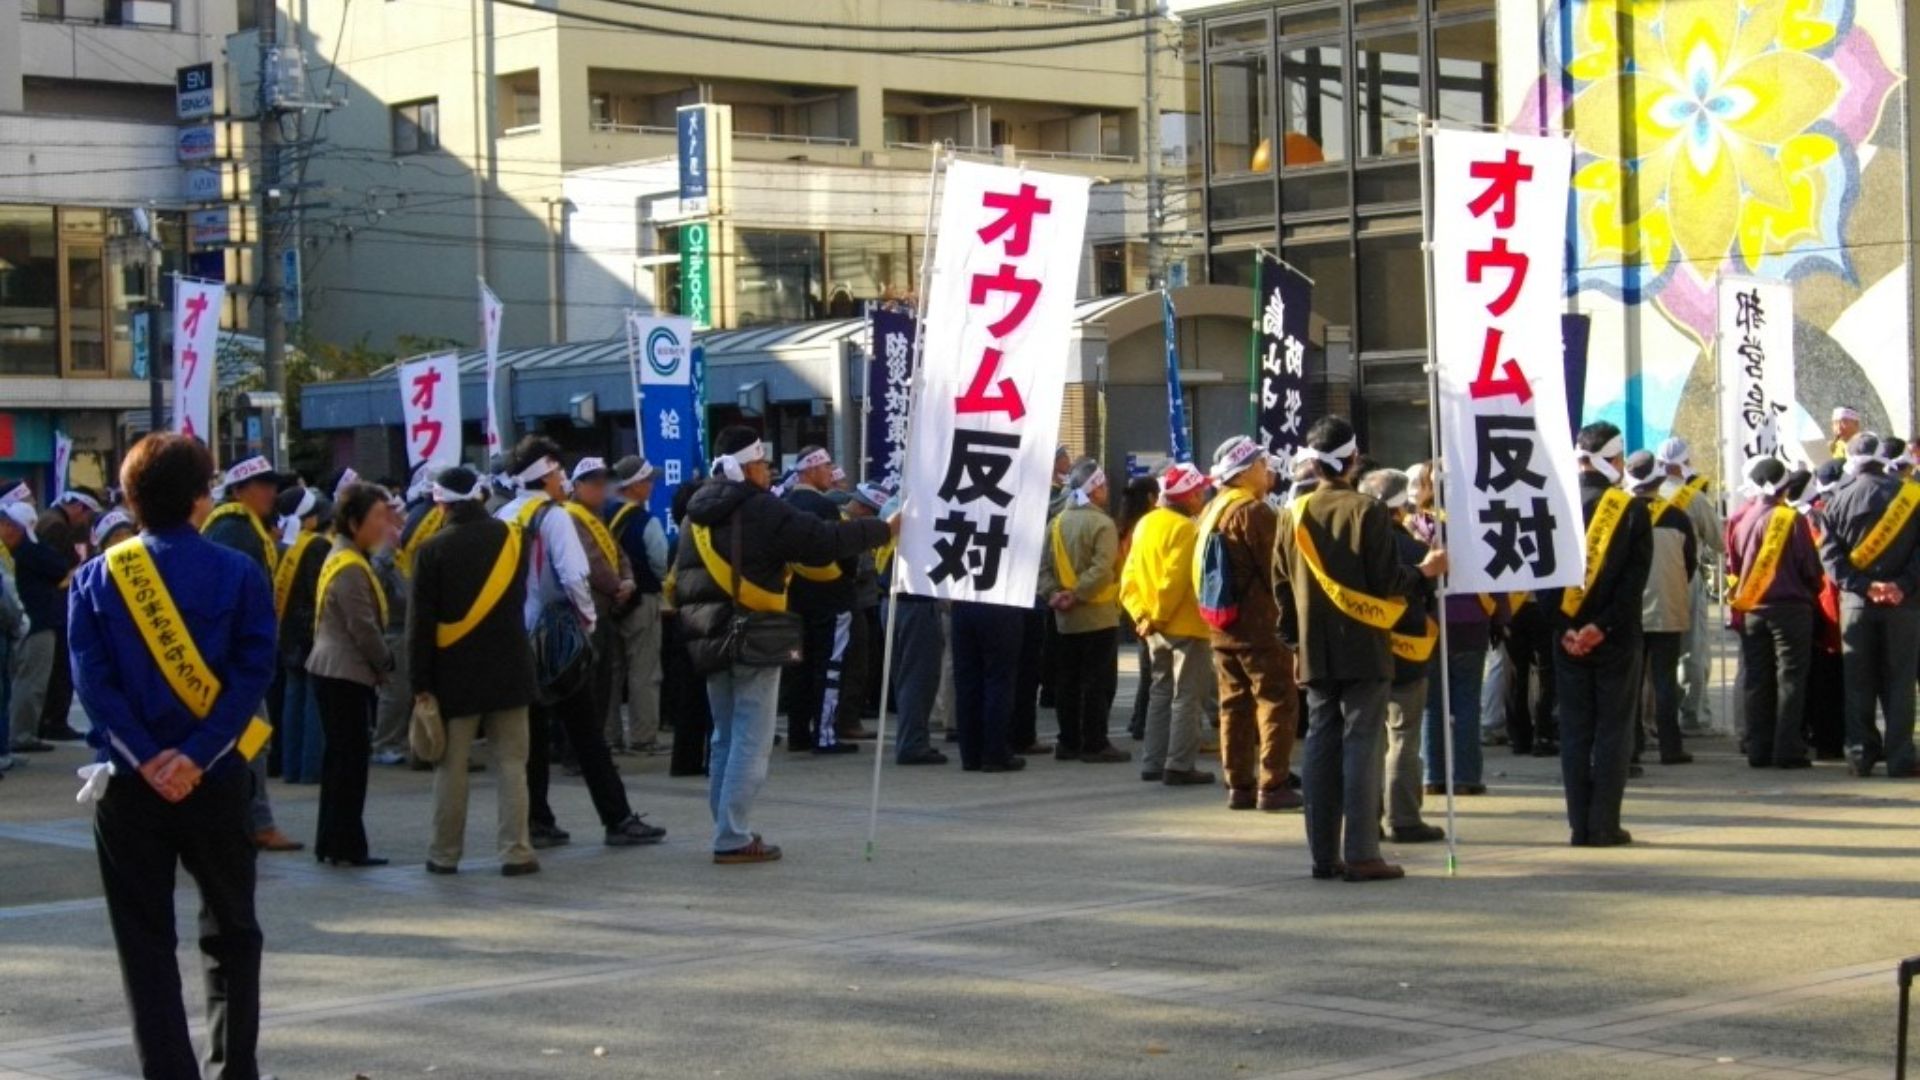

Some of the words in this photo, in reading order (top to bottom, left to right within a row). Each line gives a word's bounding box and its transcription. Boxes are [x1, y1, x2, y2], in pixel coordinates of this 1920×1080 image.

[928, 183, 1052, 593] オウム反対
[1466, 149, 1557, 580] オウム反対
